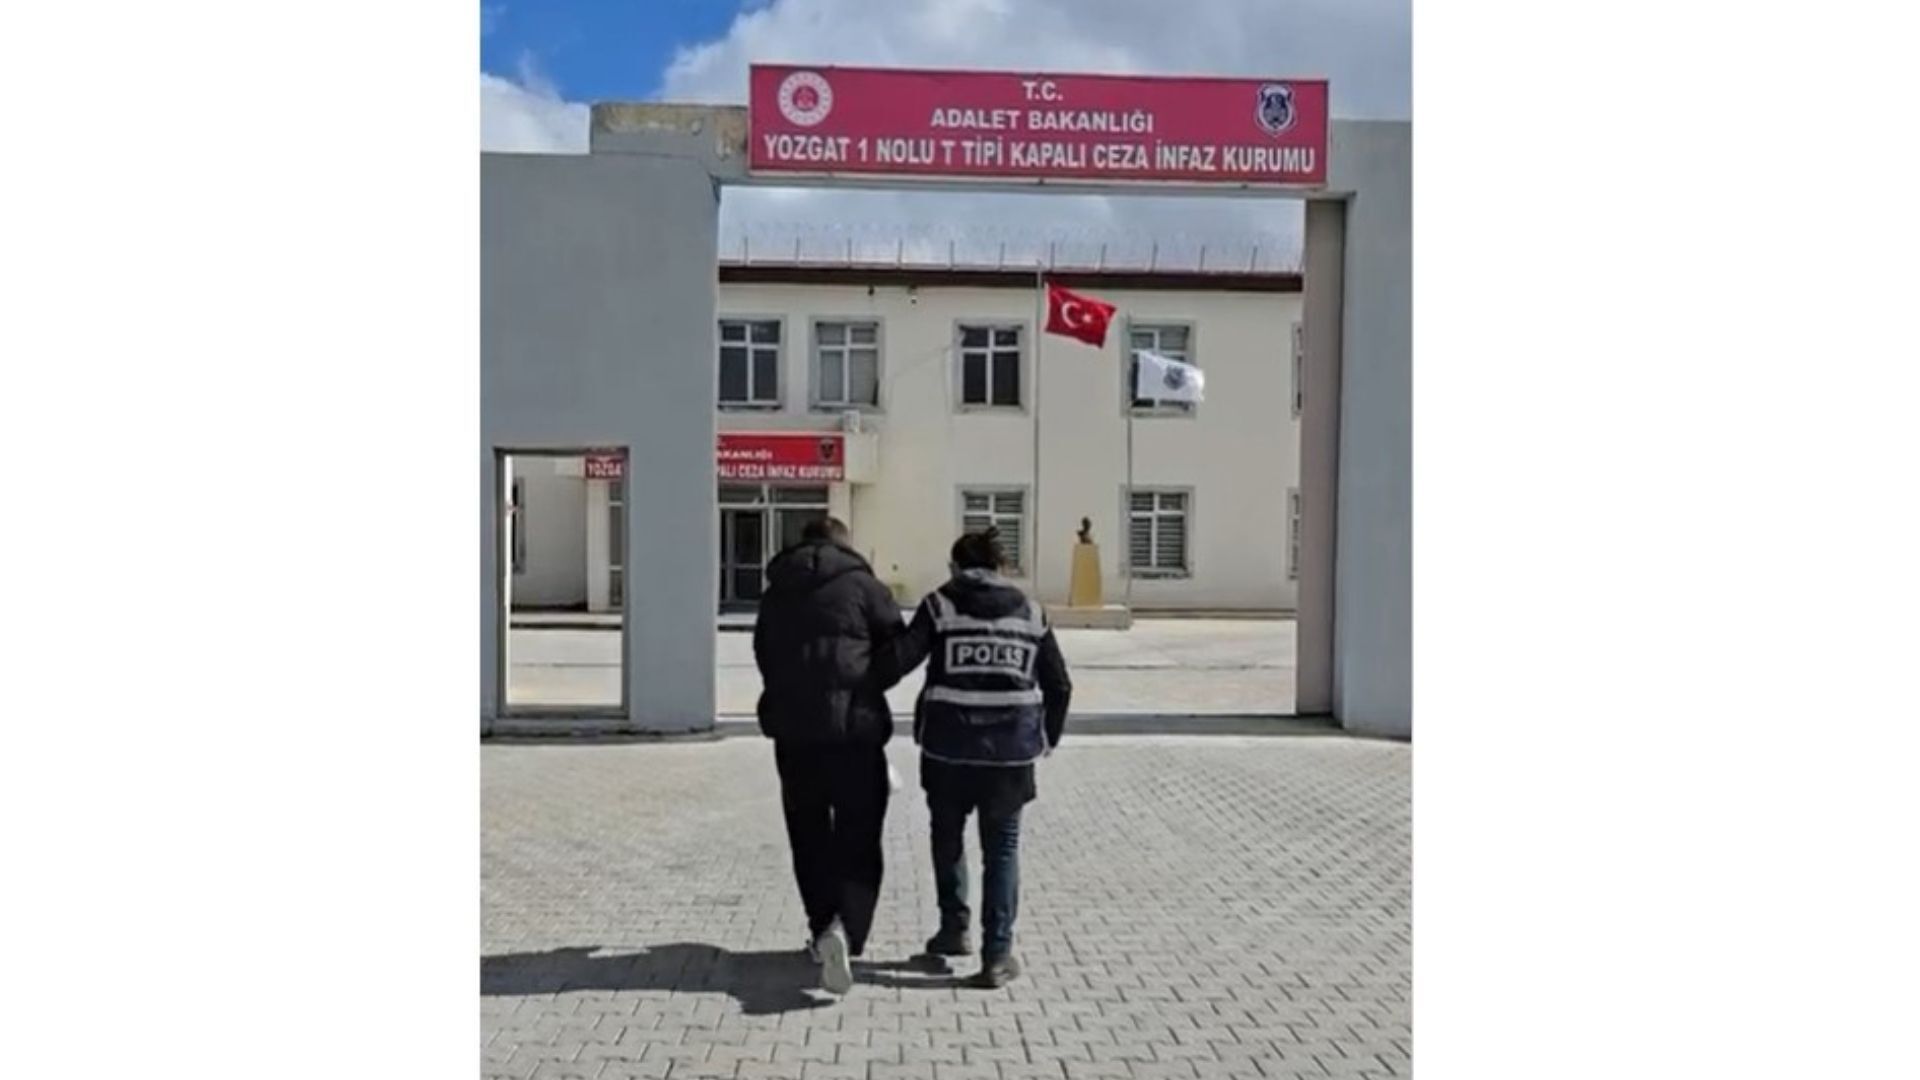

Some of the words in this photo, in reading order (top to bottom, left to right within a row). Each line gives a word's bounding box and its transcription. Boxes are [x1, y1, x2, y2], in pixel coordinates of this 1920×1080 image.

[1022, 81, 1063, 101] T.C.
[930, 108, 1020, 129] ADALET
[1028, 109, 1154, 133] BAKANLIĞI
[764, 134, 850, 161] YOZGAT
[857, 138, 868, 162] 1
[876, 138, 935, 164] NOLU
[941, 140, 956, 165] T
[961, 135, 1003, 166] TİPİ
[1011, 141, 1086, 169] KAPALI
[1093, 143, 1149, 169] CEZA
[1155, 139, 1217, 171] İNFAZ
[1223, 146, 1315, 173] KURUMU
[739, 464, 764, 478] CEZA
